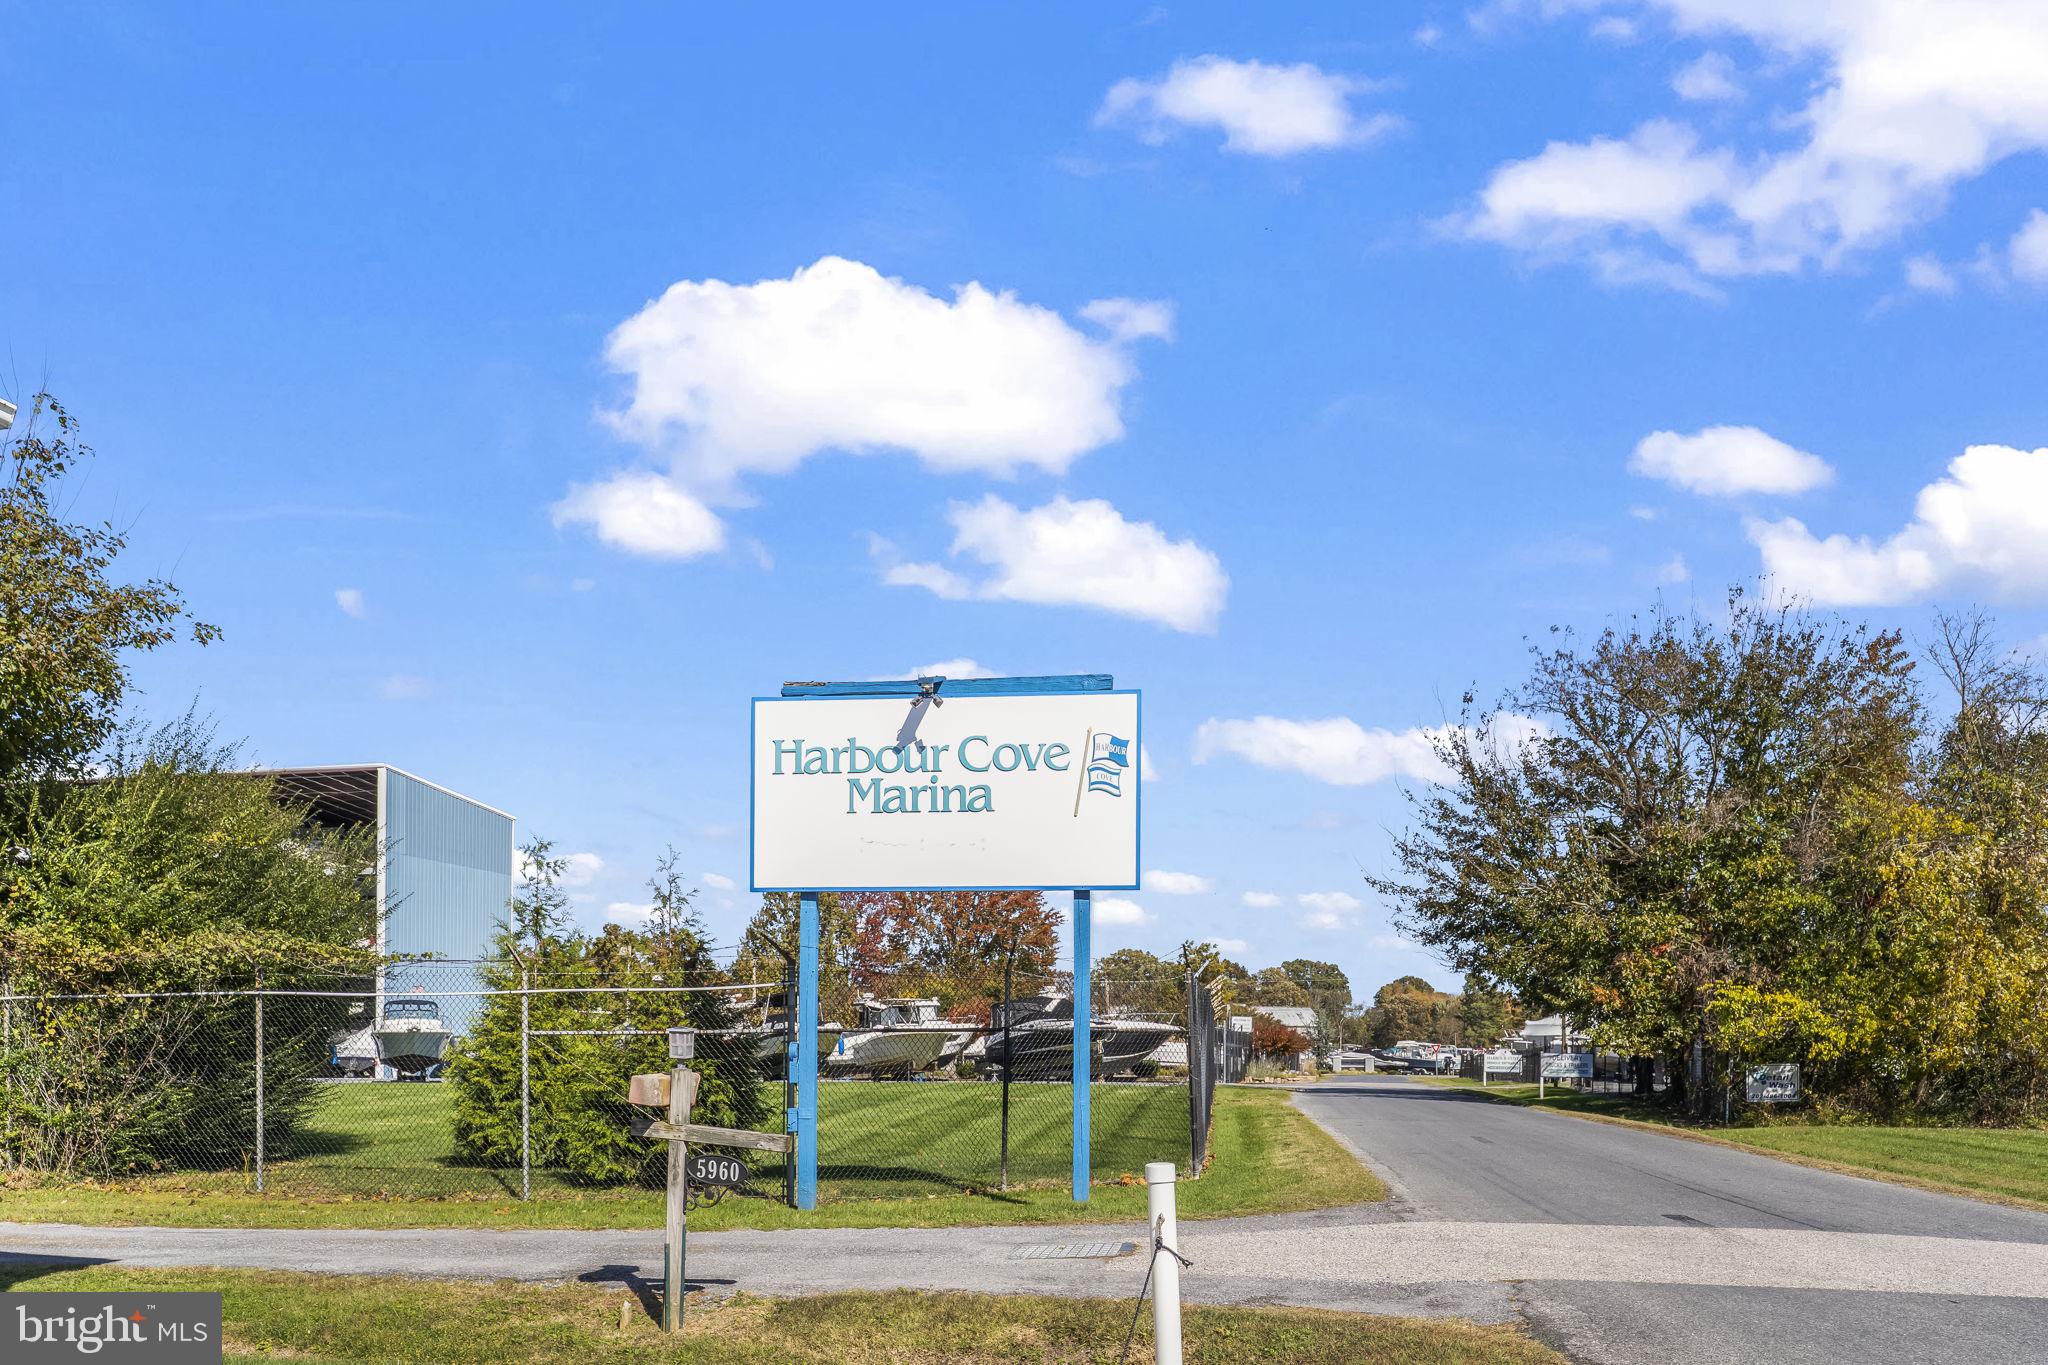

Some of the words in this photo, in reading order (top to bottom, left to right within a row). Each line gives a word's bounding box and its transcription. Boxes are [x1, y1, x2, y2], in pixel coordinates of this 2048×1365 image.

[772, 736, 949, 775] Harbour
[958, 735, 1071, 772] Cove
[1096, 743, 1127, 755] HARBOUR
[1096, 773, 1113, 782] COVE
[846, 774, 994, 814] Marina
[1769, 1081, 1796, 1089] Wash
[697, 1158, 740, 1182] 5960
